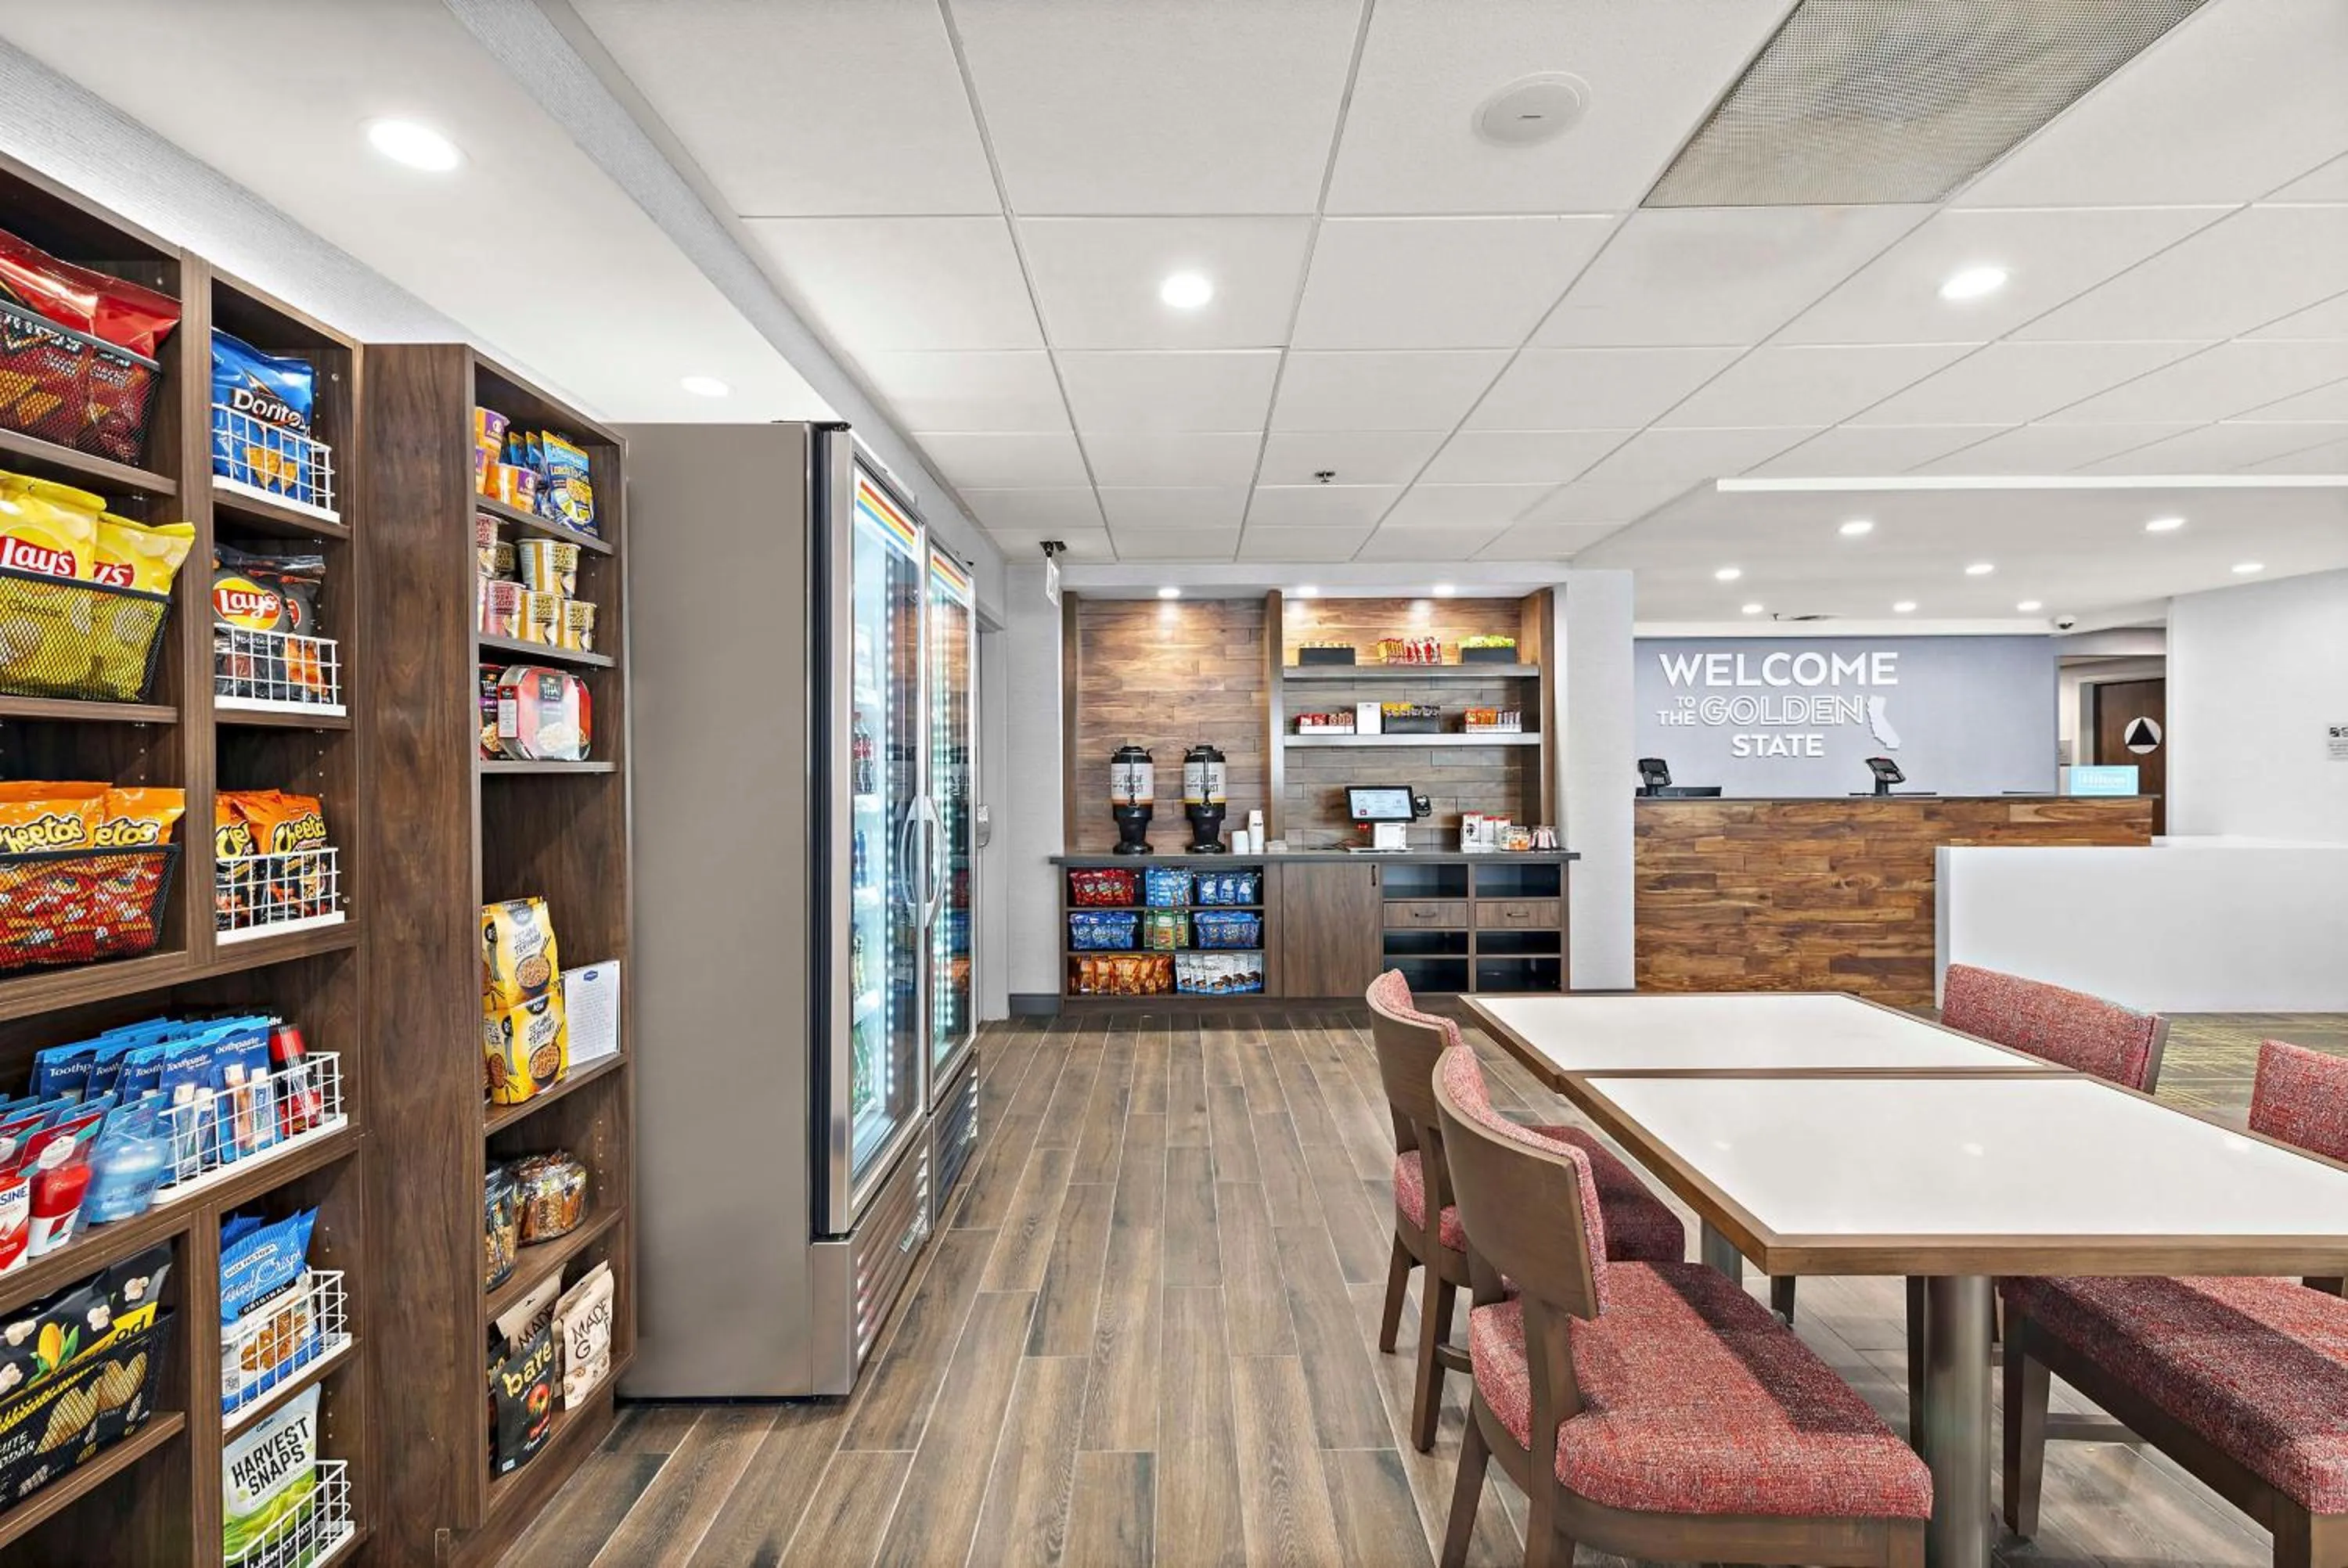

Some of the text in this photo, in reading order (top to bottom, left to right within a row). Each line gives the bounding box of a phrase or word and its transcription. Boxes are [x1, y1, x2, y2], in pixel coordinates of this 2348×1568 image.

[1658, 652, 1899, 687] WELCOME
[1657, 695, 1864, 726] THE GOLDEN
[1675, 696, 1695, 708] TO
[1731, 734, 1825, 758] STATE
[0, 817, 83, 853] heetos
[95, 818, 160, 847] etos
[50, 1063, 92, 1077] Toothp
[0, 1185, 27, 1206] SINE
[502, 1340, 553, 1398] bare
[232, 1417, 309, 1488] HARVEST
[248, 1444, 305, 1497] SNAPS
